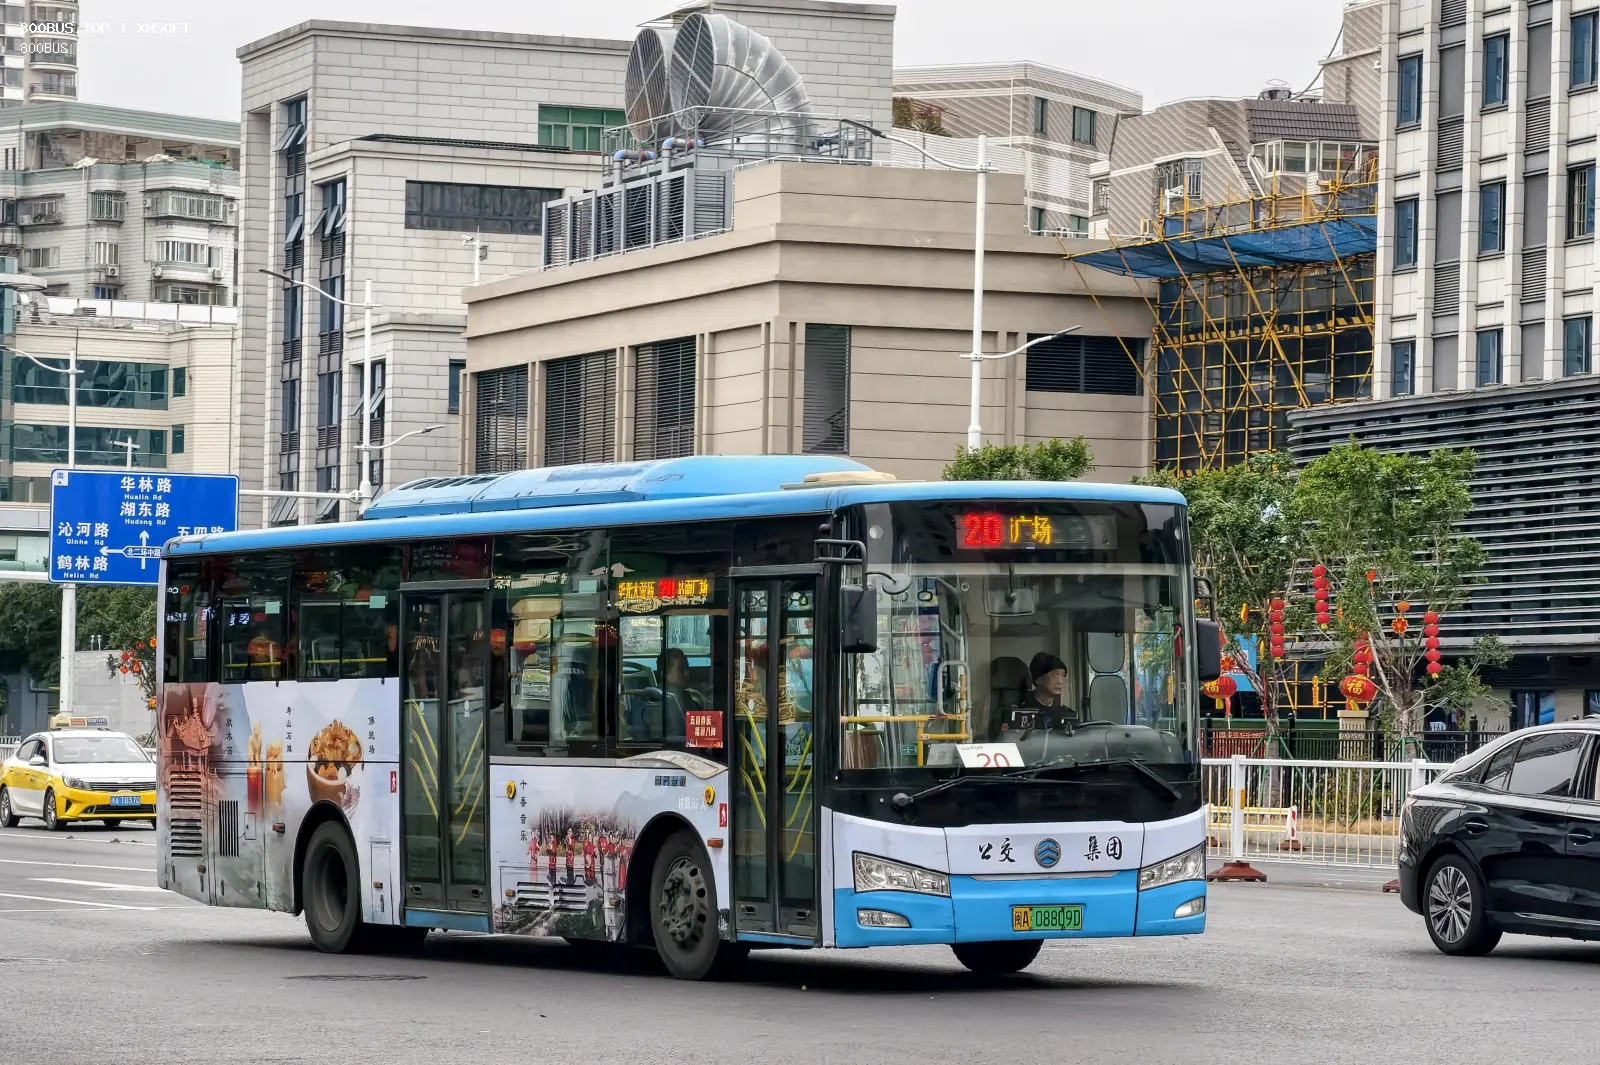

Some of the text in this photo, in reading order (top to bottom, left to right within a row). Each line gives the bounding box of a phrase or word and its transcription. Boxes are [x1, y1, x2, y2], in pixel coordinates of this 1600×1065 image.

[120, 476, 172, 493] 华林路
[124, 493, 149, 501] Hualin
[120, 501, 171, 518] 湖东路
[58, 521, 109, 538] 沁河路
[124, 518, 152, 526] Hudong
[963, 513, 1002, 545] 20
[1010, 515, 1052, 545] 广场
[66, 538, 89, 546] Qinhe
[127, 547, 161, 557] 北二环中路
[57, 555, 109, 571] 鹤林路
[1203, 681, 1219, 692] 福
[1346, 681, 1364, 695] 福
[978, 835, 1123, 863] 公交 集团
